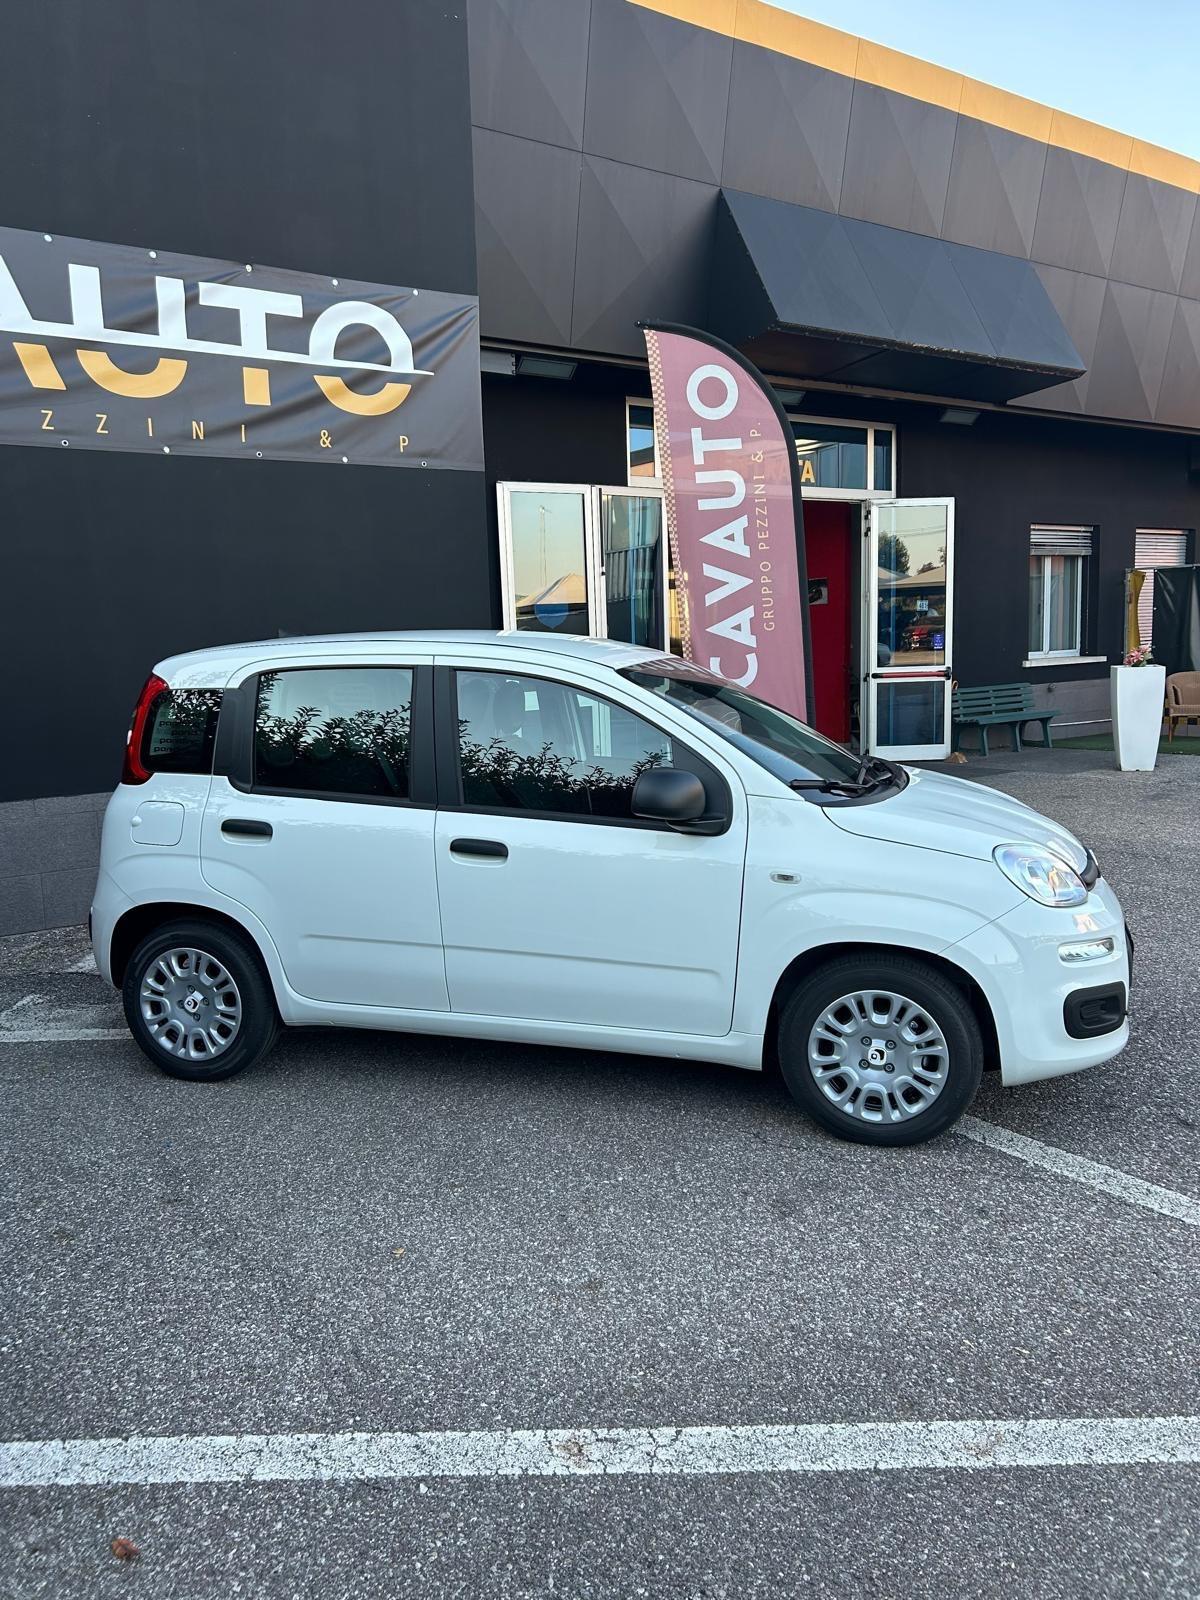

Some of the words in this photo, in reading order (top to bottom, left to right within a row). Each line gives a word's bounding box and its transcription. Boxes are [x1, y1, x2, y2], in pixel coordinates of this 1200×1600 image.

[320, 429, 332, 448] &
[399, 435, 409, 453] P
[749, 422, 761, 438] P.
[751, 449, 763, 463] &
[686, 364, 758, 689] CAVAUTO
[753, 475, 770, 550] PEZZINI
[759, 561, 775, 631] GRUPPO
